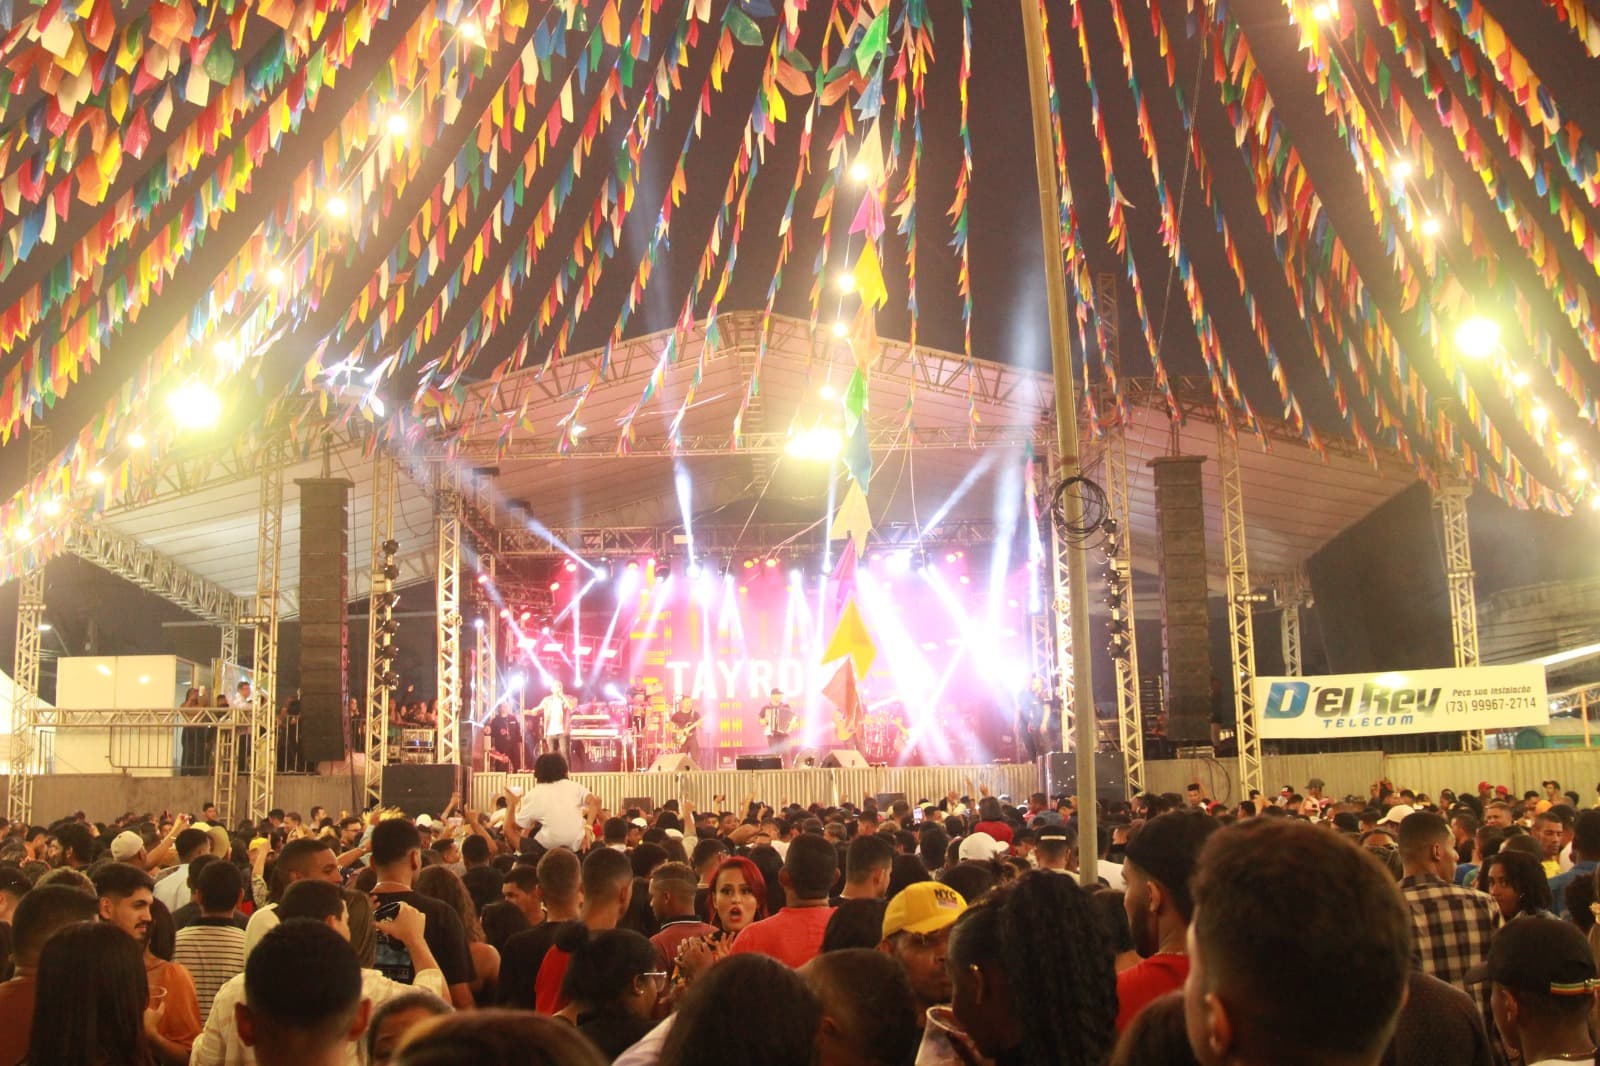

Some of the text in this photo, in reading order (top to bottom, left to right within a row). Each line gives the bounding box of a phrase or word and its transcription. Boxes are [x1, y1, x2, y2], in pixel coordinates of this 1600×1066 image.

[1474, 688, 1488, 696] sua
[1359, 682, 1442, 718] Rey
[1445, 697, 1537, 714] (73) 99967-2714
[1323, 715, 1414, 729] TELECOM
[934, 888, 958, 901] NYC
